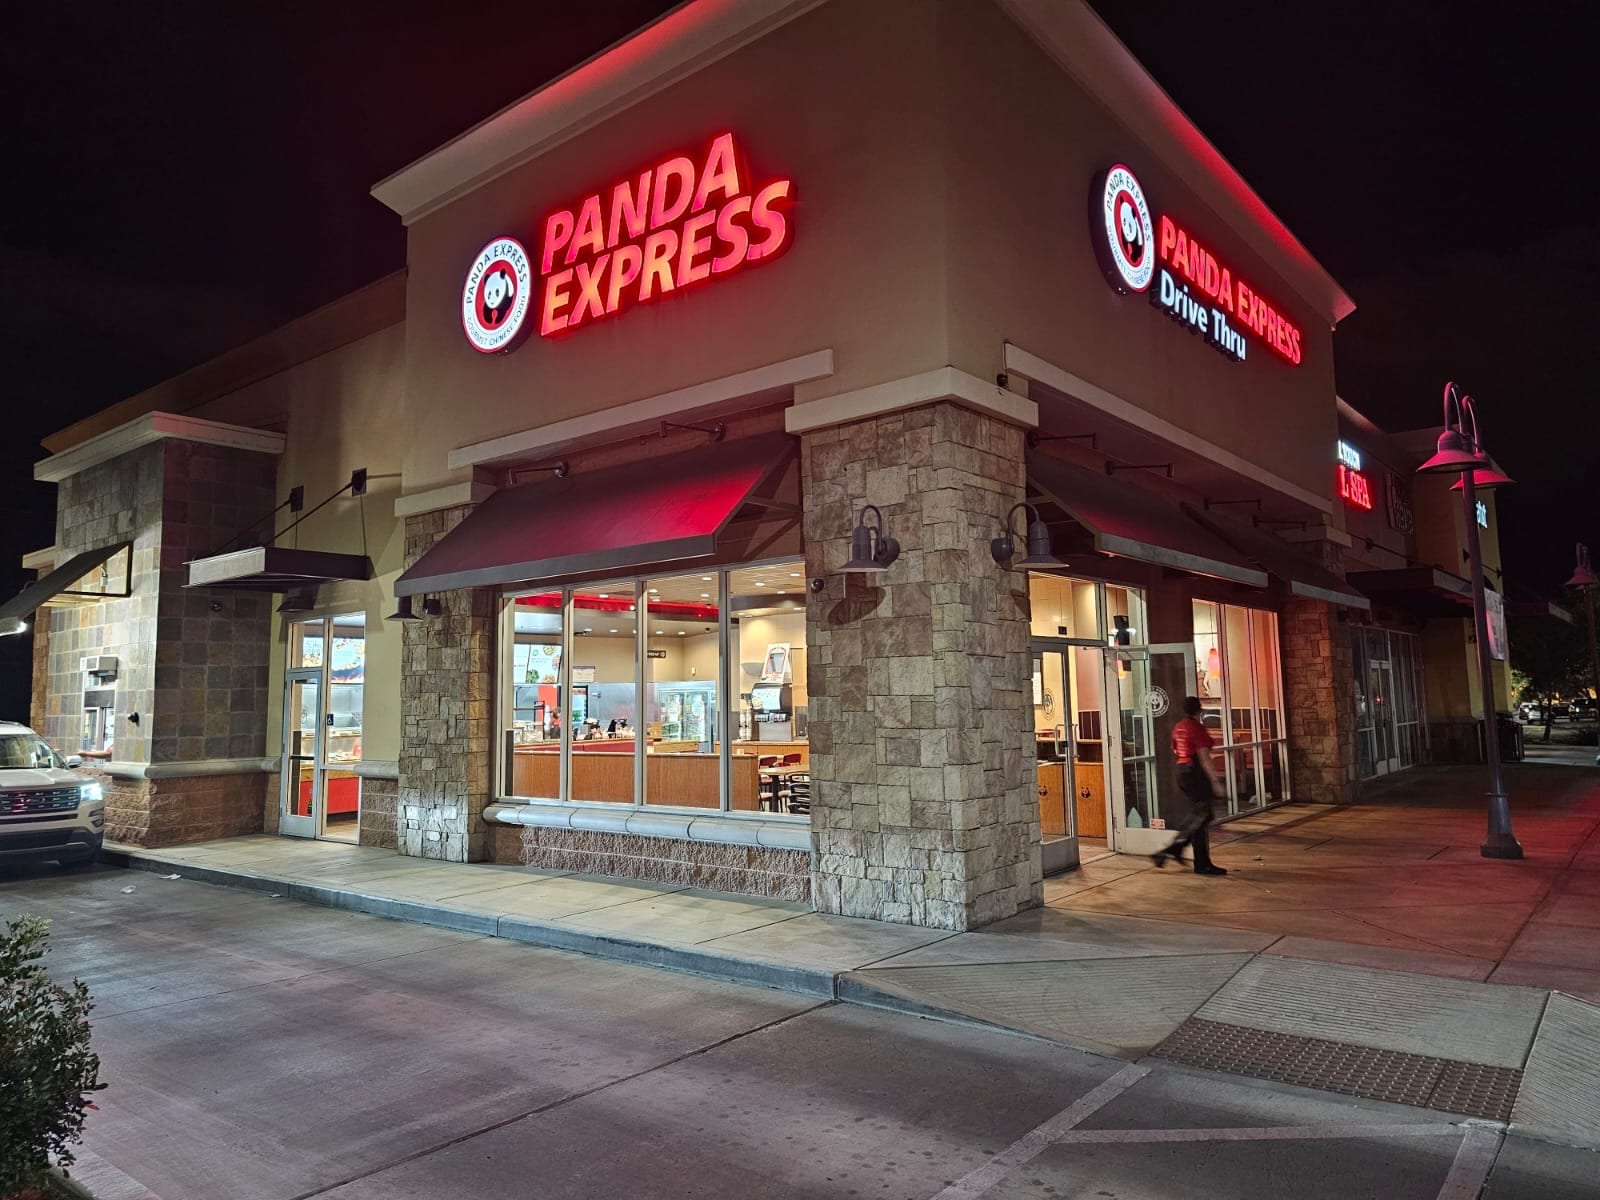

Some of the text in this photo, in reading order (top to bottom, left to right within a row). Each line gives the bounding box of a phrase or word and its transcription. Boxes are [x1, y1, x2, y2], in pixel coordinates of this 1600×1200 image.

[541, 132, 740, 276] PANDA
[1106, 172, 1125, 212] PANDA
[466, 243, 528, 304] PANDA EXPRESS
[541, 180, 790, 336] EXPRESS
[1160, 215, 1301, 365] PANDA EXPRESS
[1160, 269, 1208, 334] Drive
[1211, 308, 1246, 361] Thru
[1350, 470, 1372, 510] SPA
